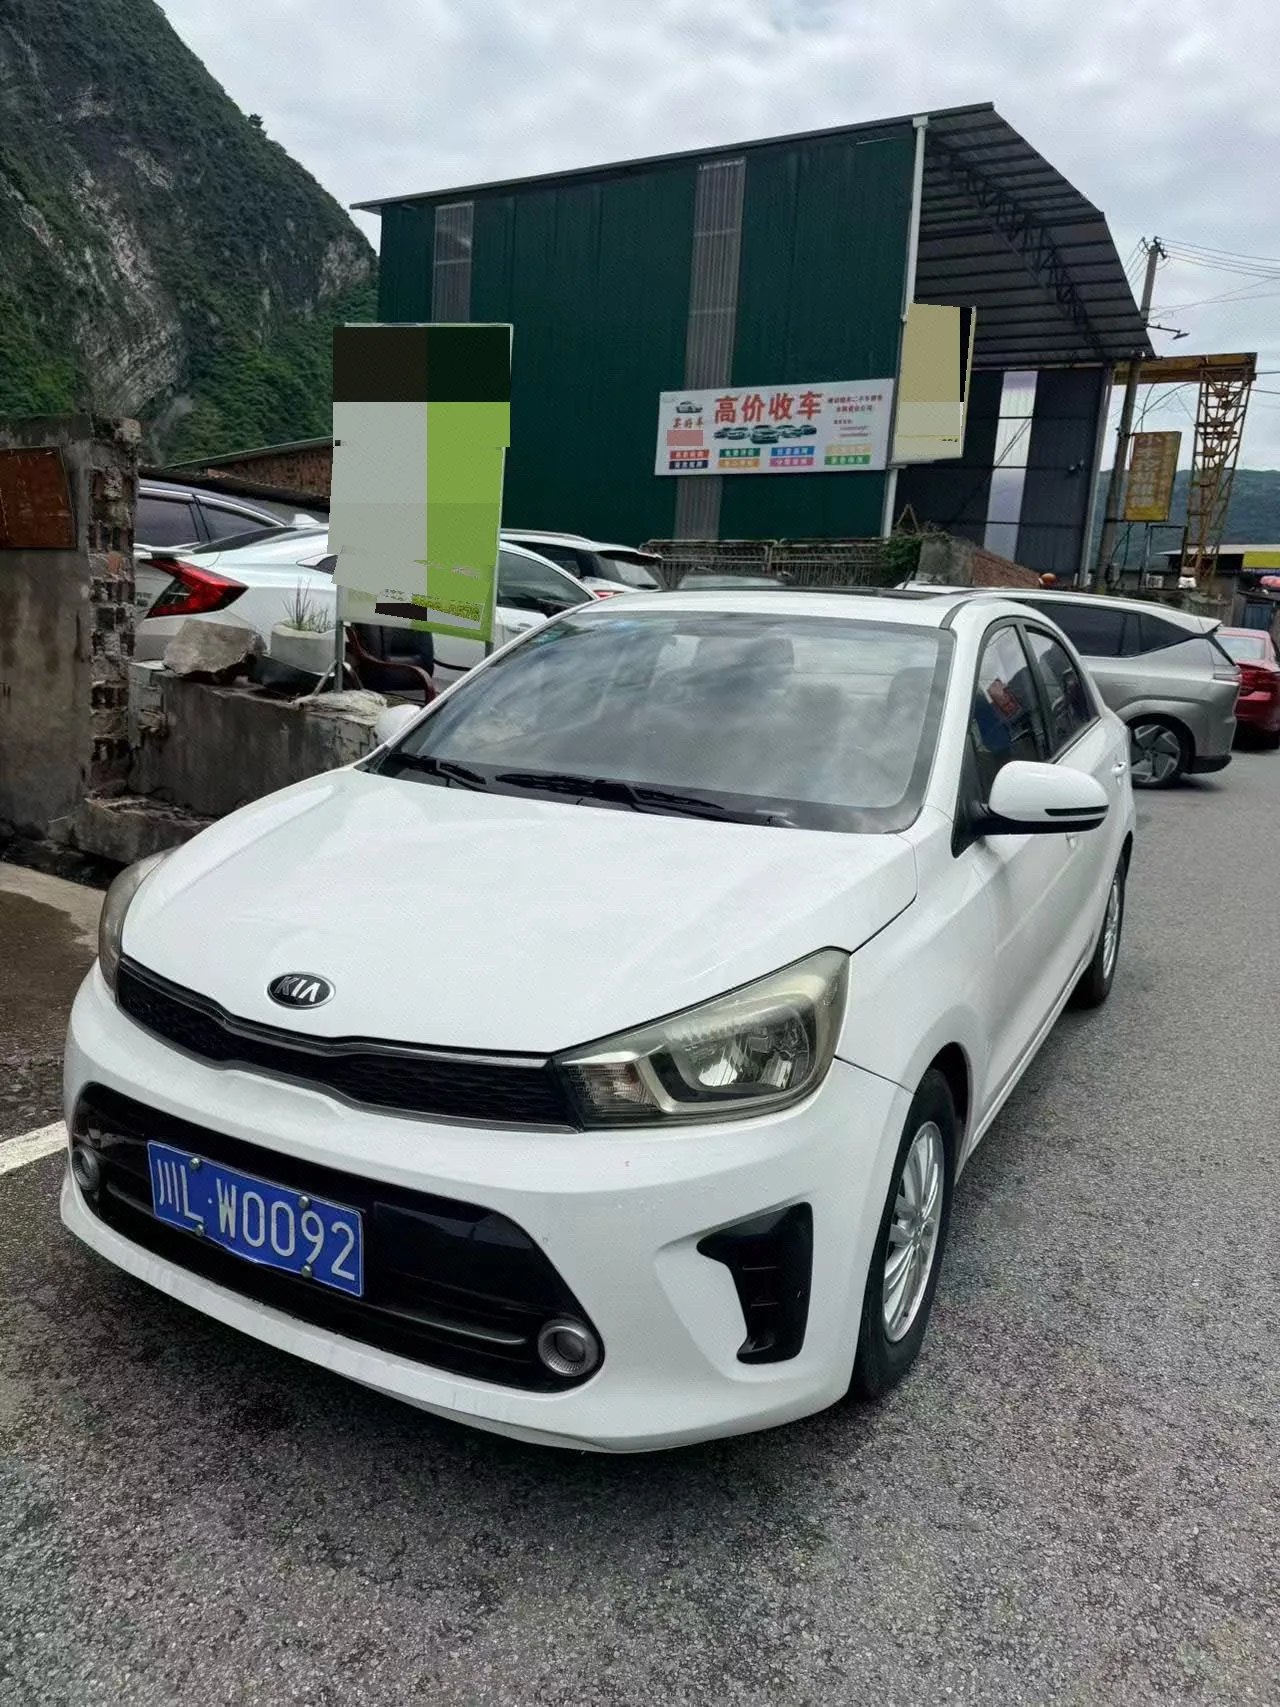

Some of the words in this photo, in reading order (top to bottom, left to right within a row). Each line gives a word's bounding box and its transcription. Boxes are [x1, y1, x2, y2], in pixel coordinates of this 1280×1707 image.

[715, 391, 824, 424] 高价收车
[274, 976, 321, 1002] KIA
